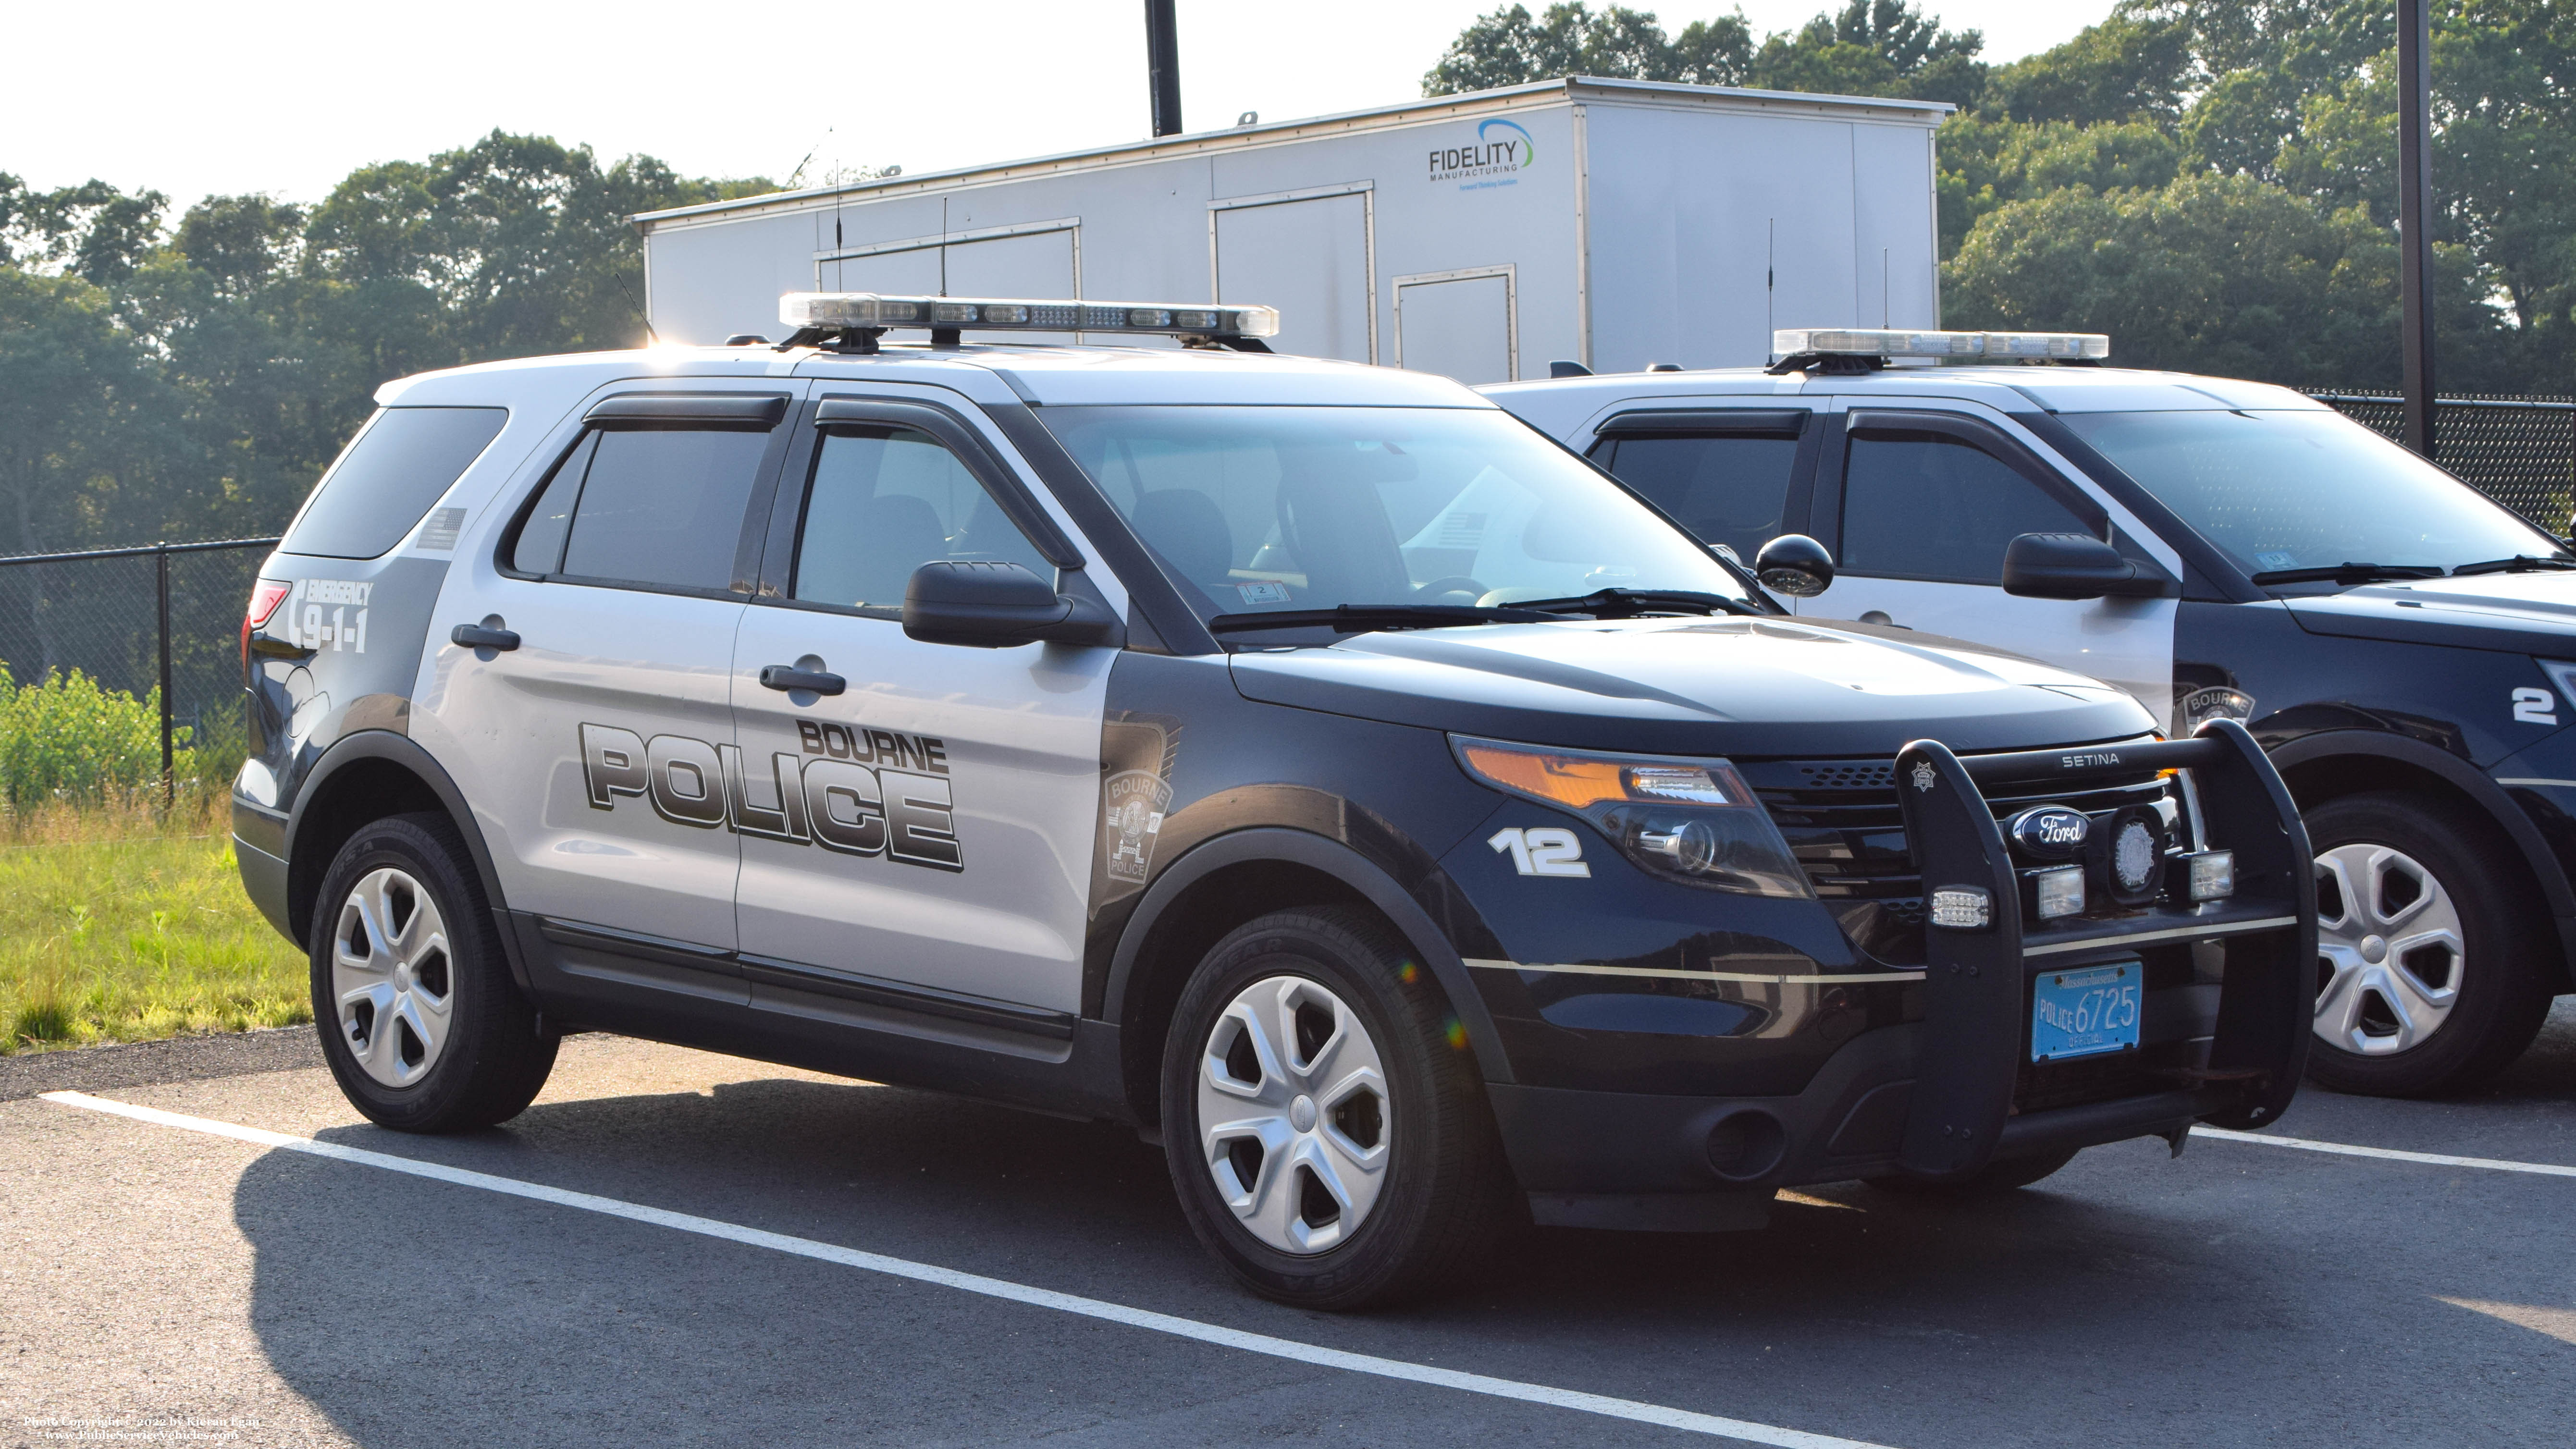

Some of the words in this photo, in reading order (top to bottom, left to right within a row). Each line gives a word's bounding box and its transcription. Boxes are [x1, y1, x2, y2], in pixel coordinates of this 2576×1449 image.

[1430, 140, 1517, 172] FIDELITY
[1430, 164, 1517, 181] MANUFACTURING
[306, 579, 374, 606] EMERGENCY
[304, 605, 369, 653] 9-1-1
[2191, 692, 2249, 712] BOURNE
[2512, 687, 2557, 725] 2
[795, 719, 950, 774] BOURNE
[2062, 753, 2120, 767] SETINA
[578, 722, 965, 873] POLICE
[1111, 777, 1168, 807] BOURNE
[2039, 815, 2082, 844] Ford
[1487, 827, 1591, 878] 12
[1111, 860, 1145, 876] POLICE
[2061, 972, 2119, 989] Massachusetts
[2040, 998, 2073, 1033] POLICE
[2076, 985, 2136, 1033] 6725
